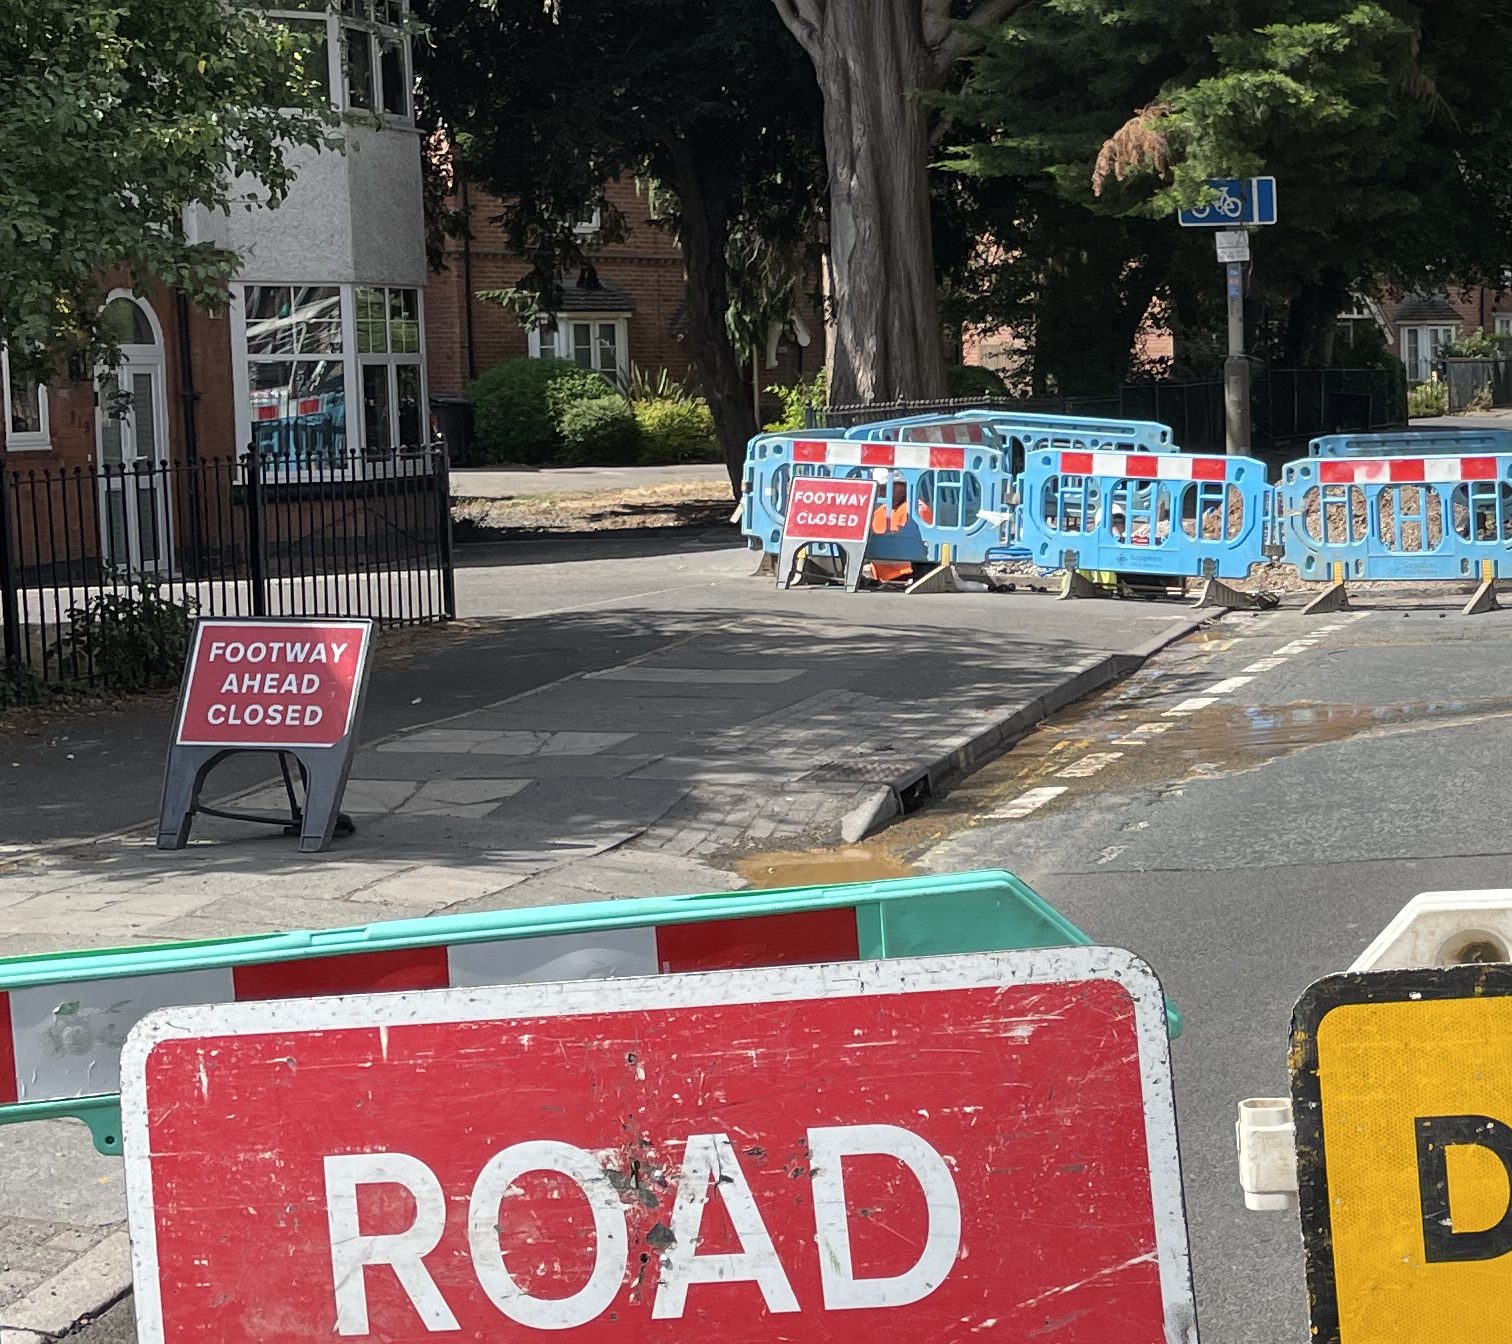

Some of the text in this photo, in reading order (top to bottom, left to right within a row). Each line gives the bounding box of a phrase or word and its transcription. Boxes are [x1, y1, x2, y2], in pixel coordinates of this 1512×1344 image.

[794, 491, 869, 507] FOOTWAY
[796, 512, 859, 527] CLOSED
[208, 642, 348, 663] FOOTWAY
[220, 673, 320, 694] AHEAD
[207, 704, 323, 726] CLOSED
[323, 1123, 962, 1337] ROAD
